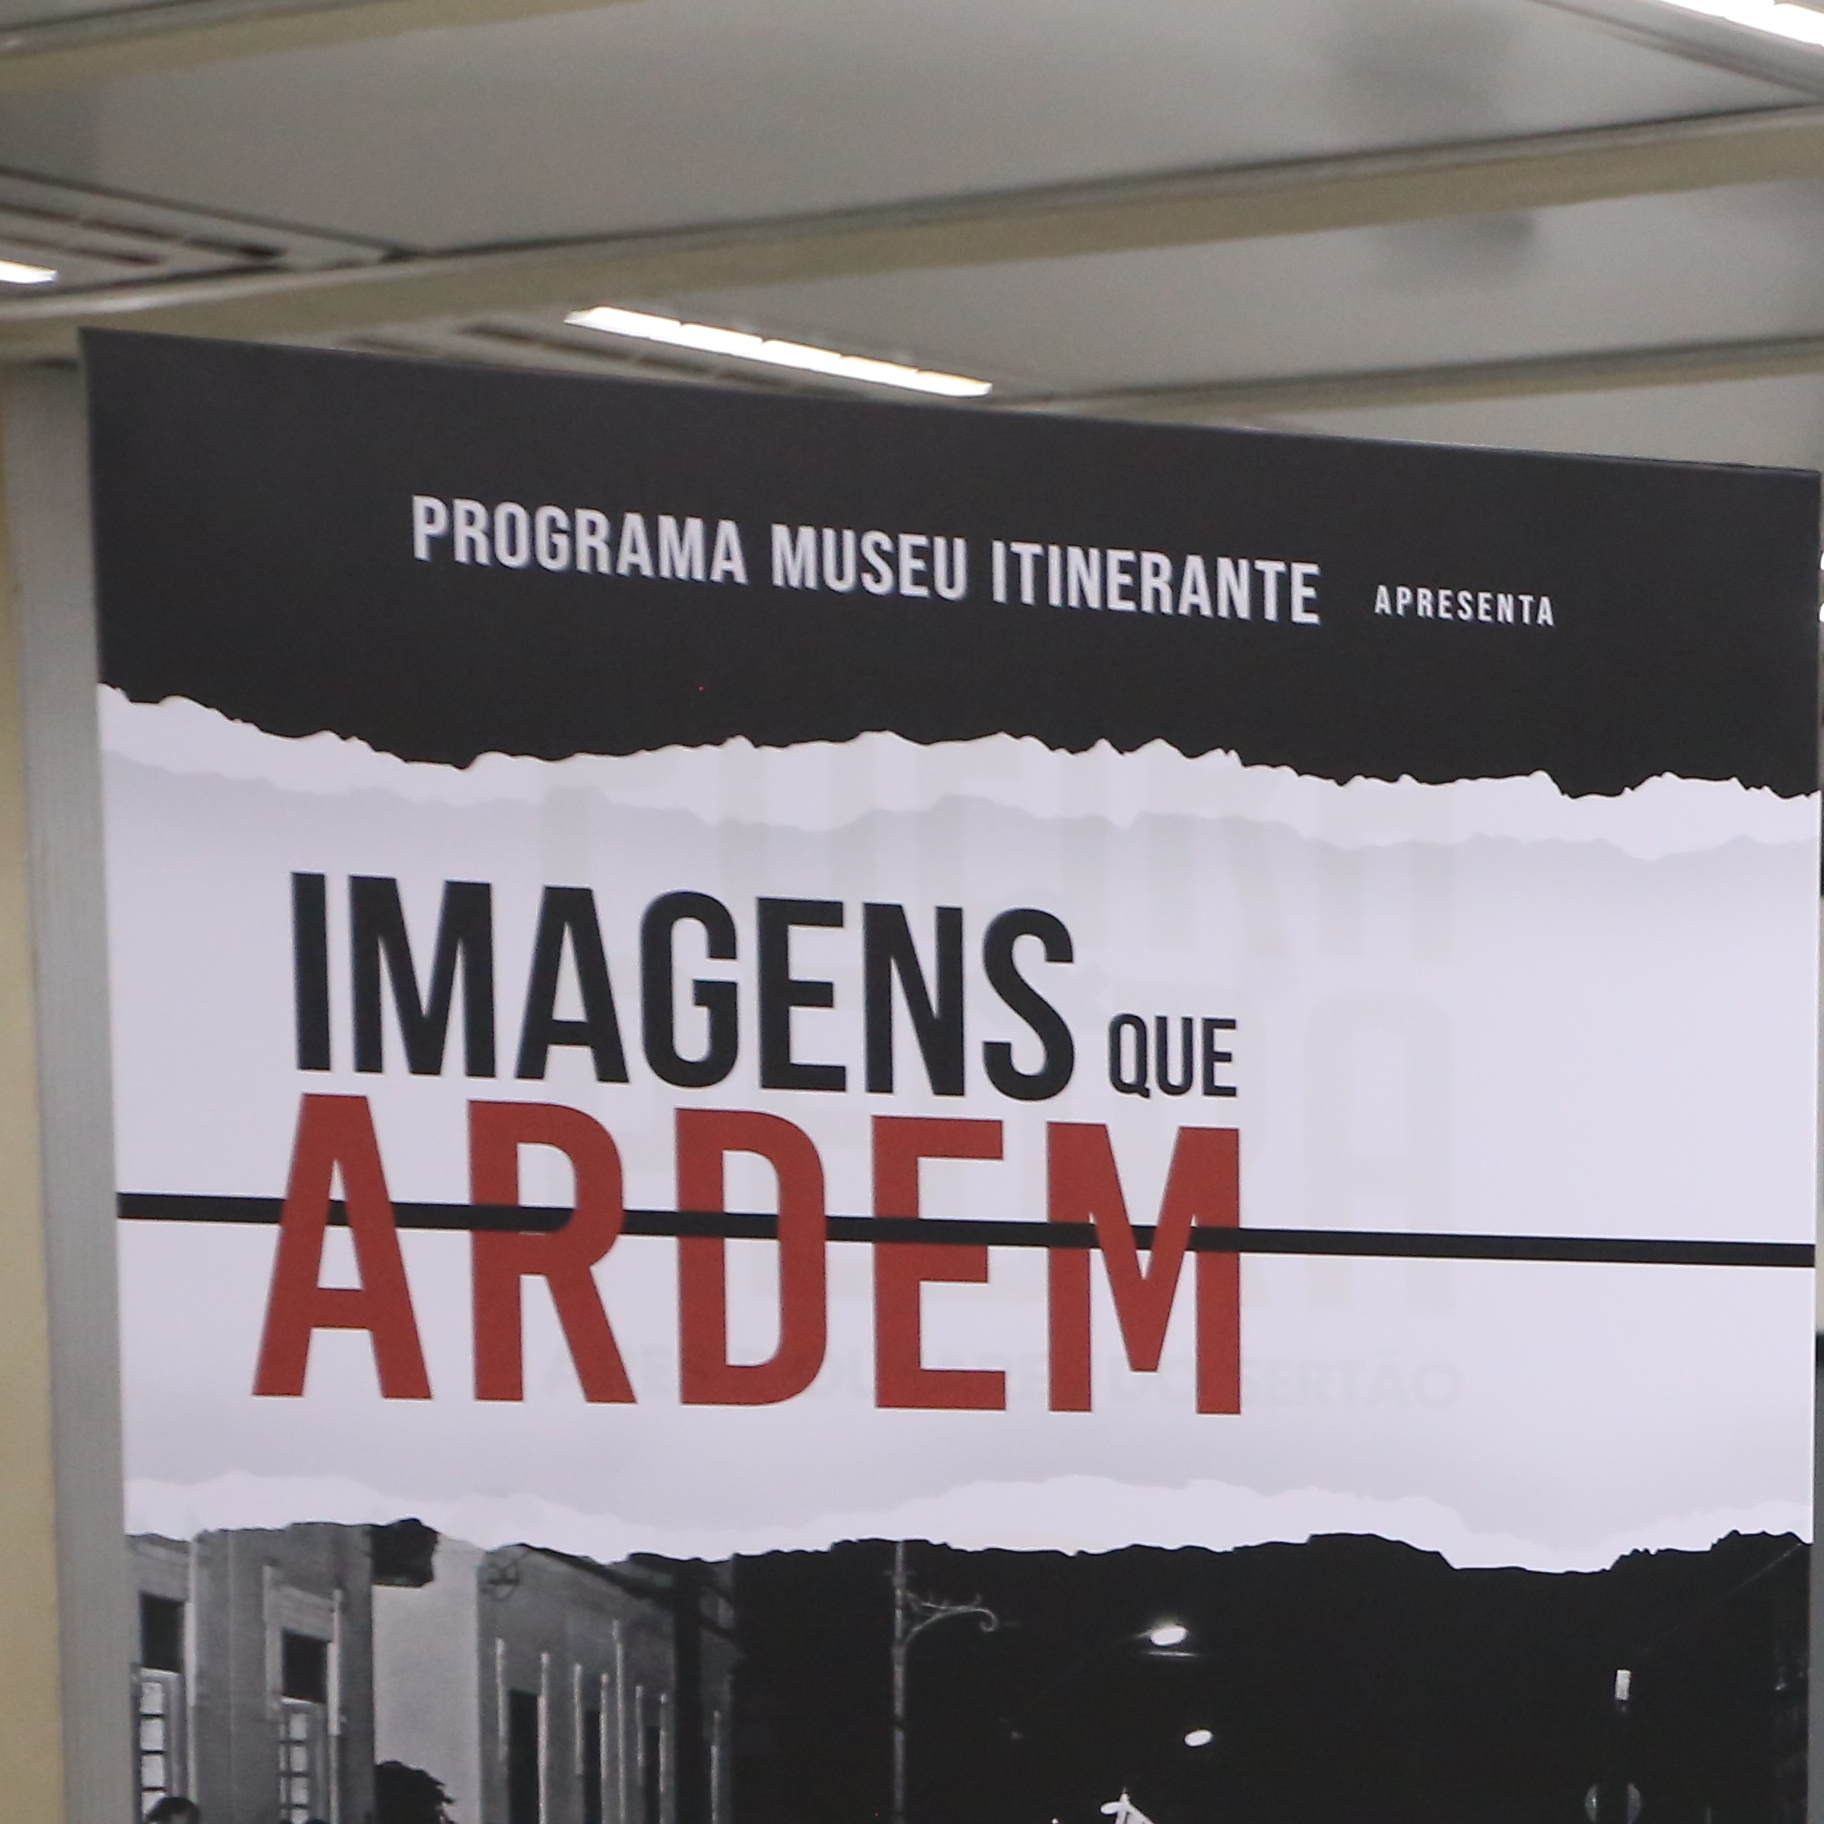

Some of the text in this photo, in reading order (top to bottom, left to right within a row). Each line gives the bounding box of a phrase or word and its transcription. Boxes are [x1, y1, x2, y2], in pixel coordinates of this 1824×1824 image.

[413, 496, 1553, 625] PROGRAMA MUSEU ITINERANTE APRESENTA
[292, 872, 1236, 1100] IMAGENS QUE
[251, 1094, 1240, 1414] ARDEM
